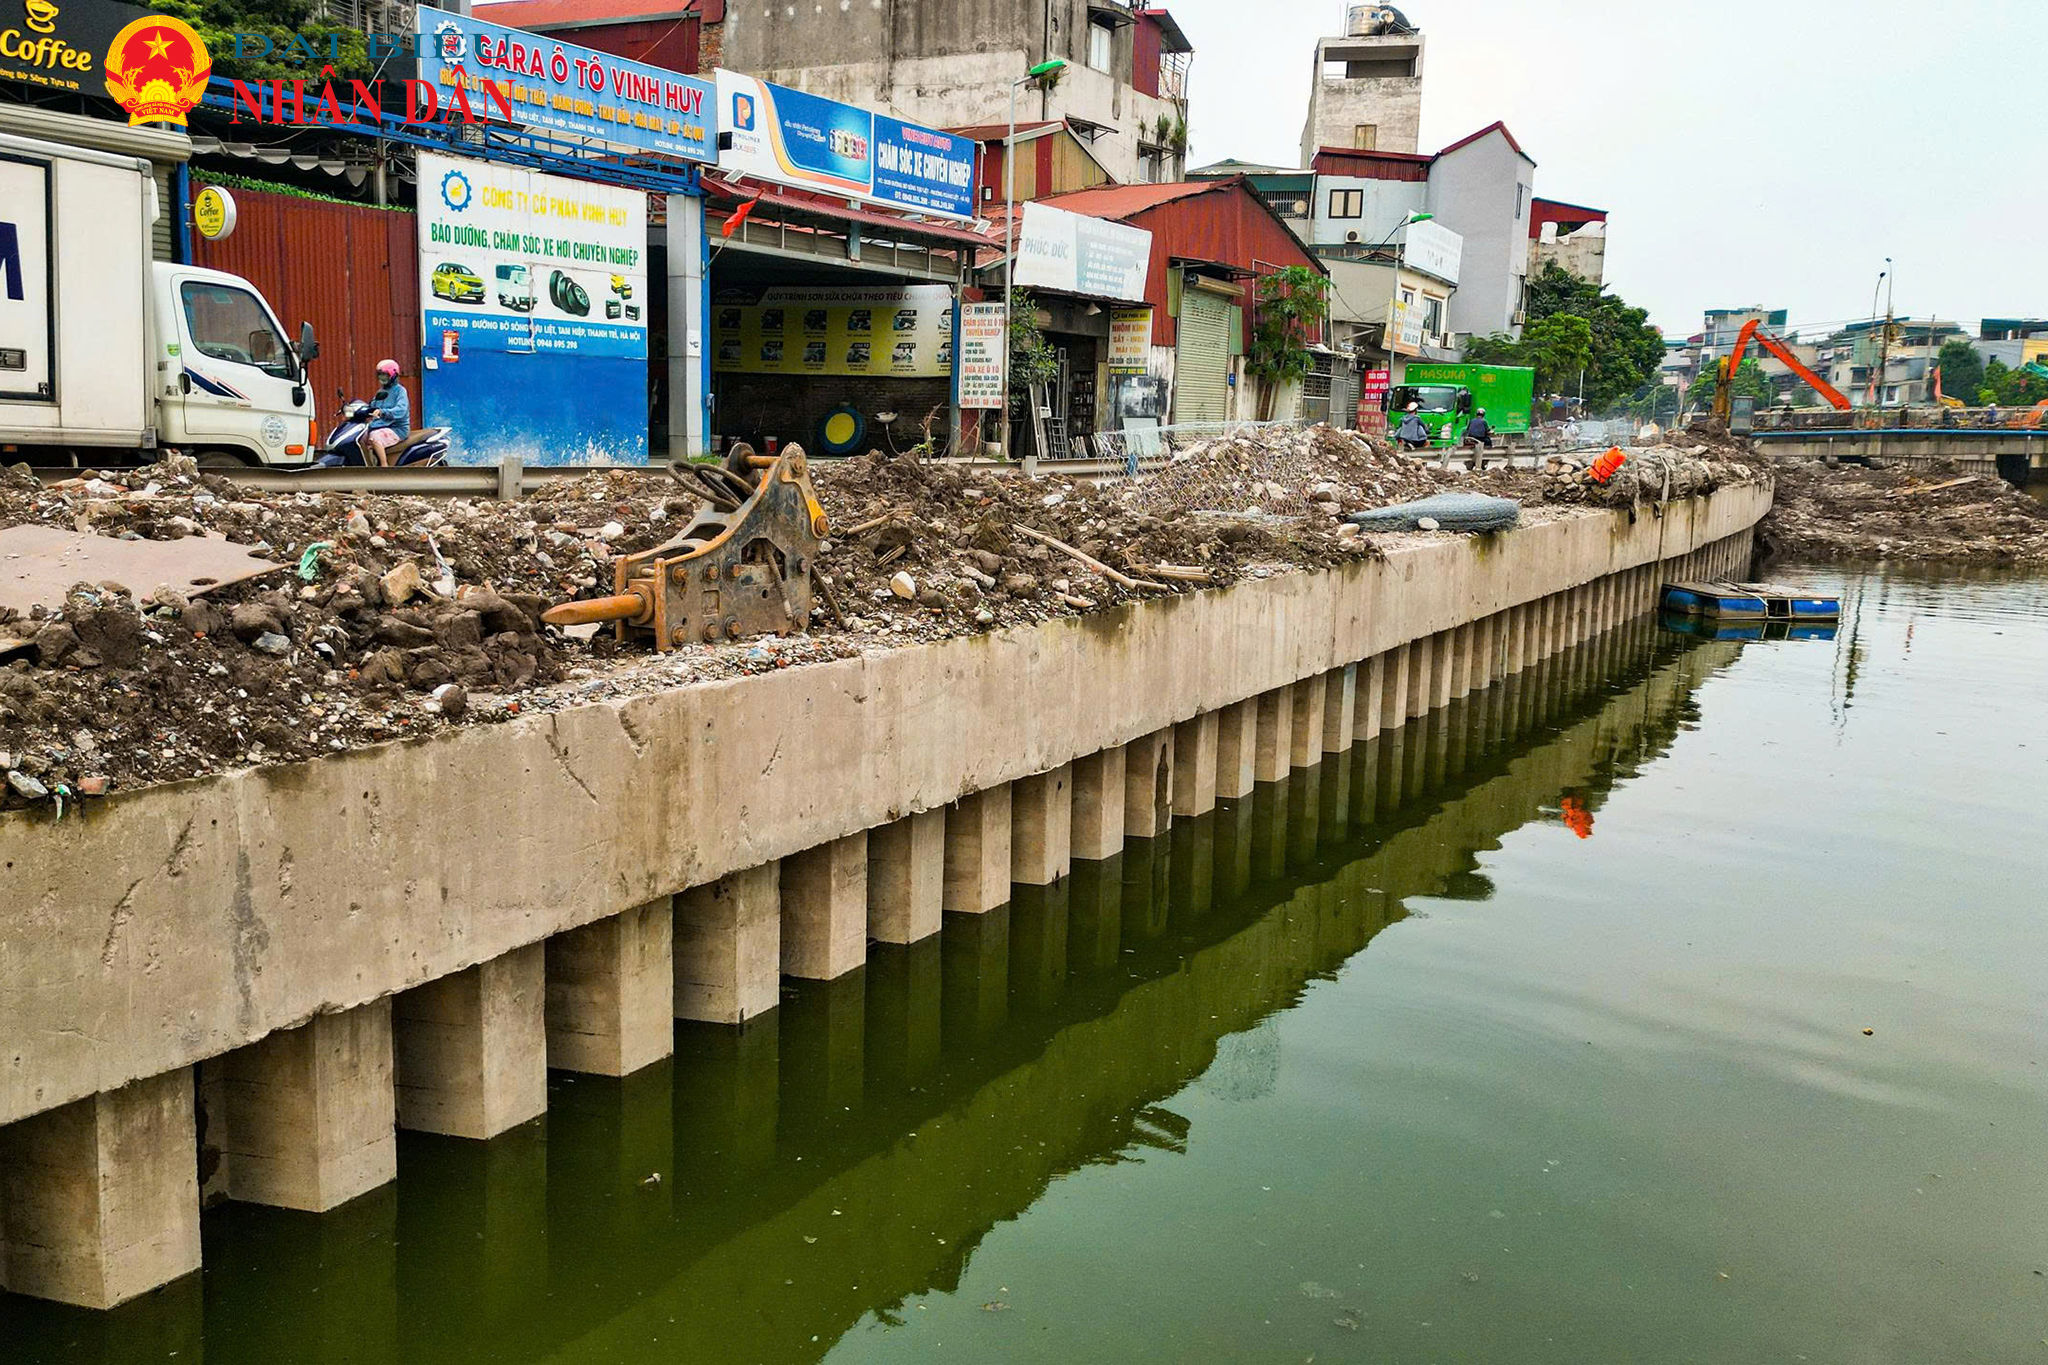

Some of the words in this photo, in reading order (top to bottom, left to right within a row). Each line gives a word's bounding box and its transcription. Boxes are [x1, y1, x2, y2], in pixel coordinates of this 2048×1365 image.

[0, 29, 92, 71] Coffee
[475, 35, 546, 80] GARA
[551, 45, 569, 83] Ô
[574, 55, 605, 92] TÔ
[611, 67, 660, 106] VINH
[665, 82, 704, 116] HUY
[899, 144, 913, 175] SÓC
[431, 217, 451, 243] BẢO
[523, 233, 541, 255] SÓC
[543, 238, 554, 256] XE
[557, 239, 571, 259] HƠI
[573, 241, 606, 263] CHUYÊN
[609, 246, 639, 270] NGHIỆP
[862, 292, 885, 301] THEO
